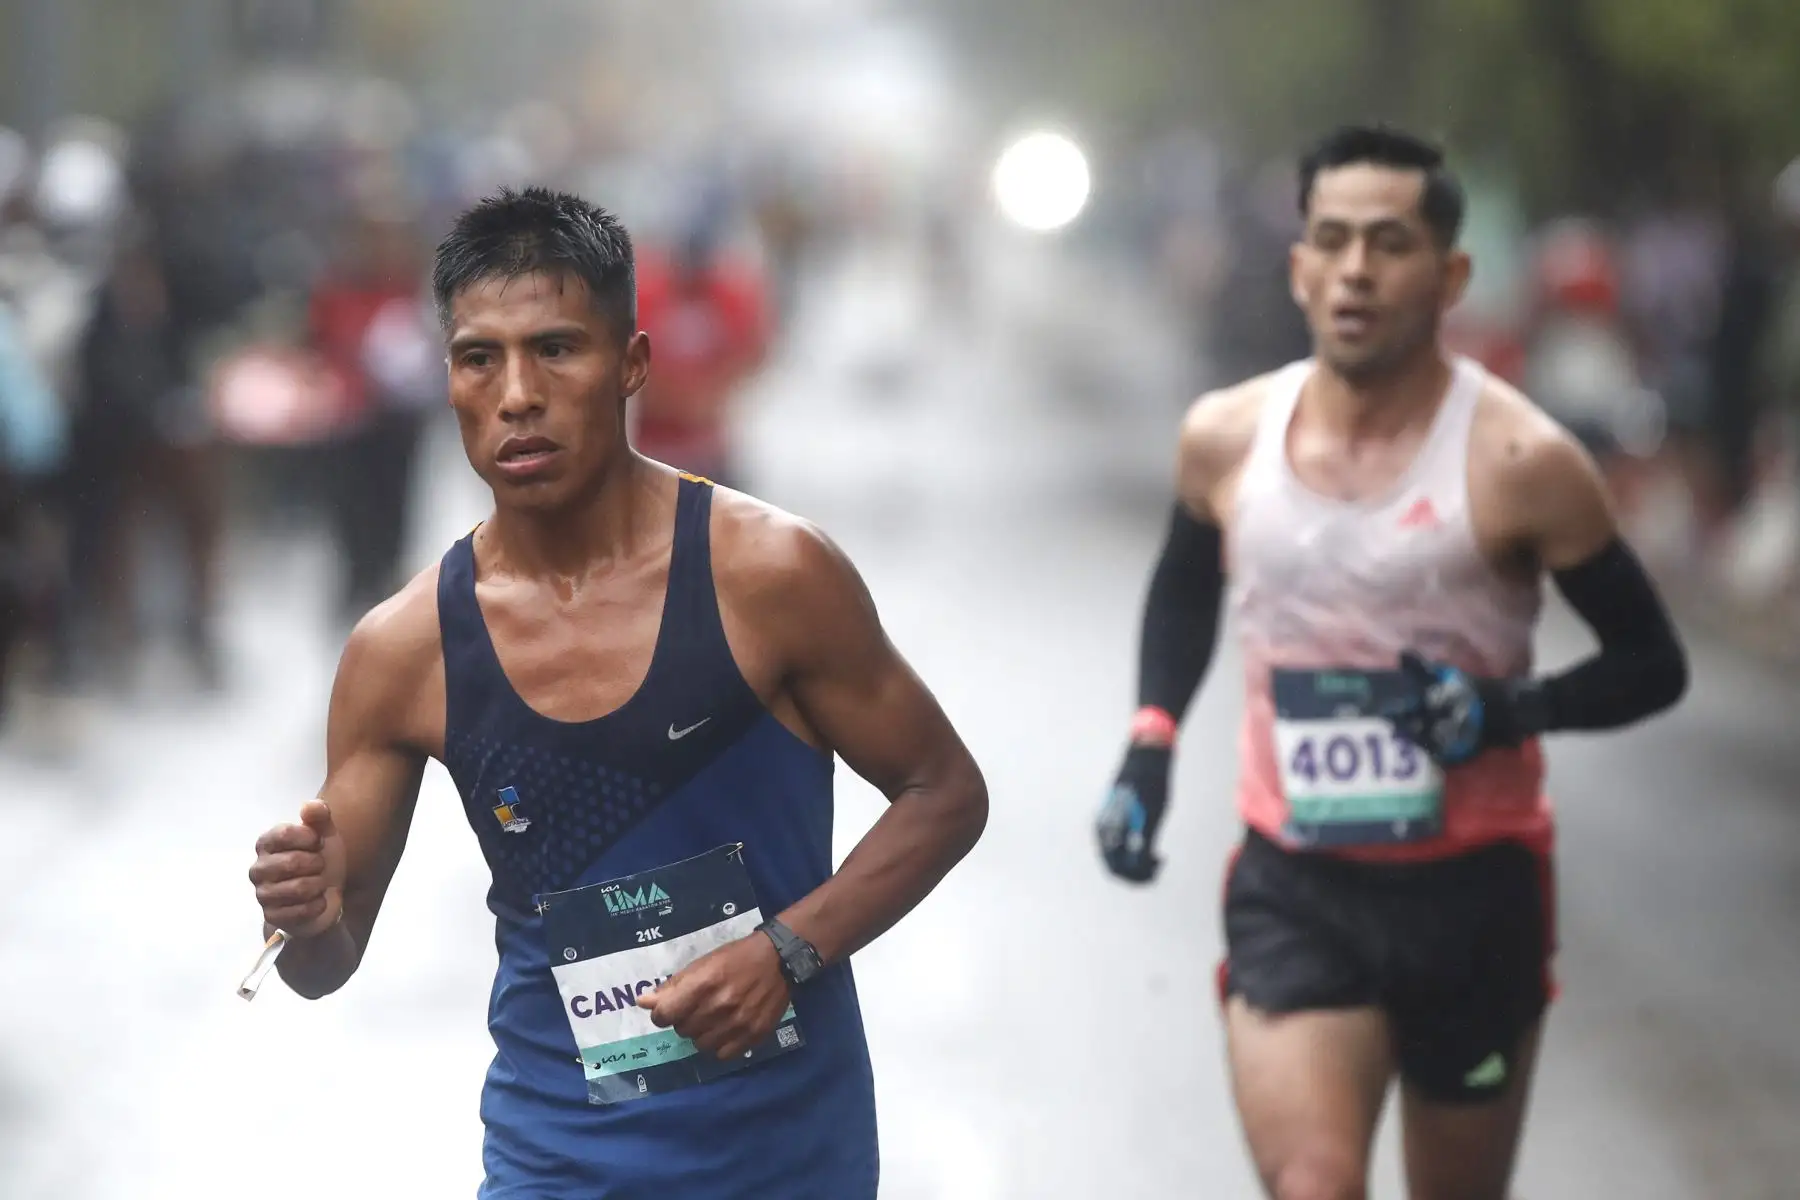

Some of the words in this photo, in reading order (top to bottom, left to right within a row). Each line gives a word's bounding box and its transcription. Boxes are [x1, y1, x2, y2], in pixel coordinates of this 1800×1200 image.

[1291, 735, 1418, 783] 4013
[603, 882, 671, 913] LIMA
[635, 926, 663, 943] 21K
[570, 974, 674, 1018] CANC
